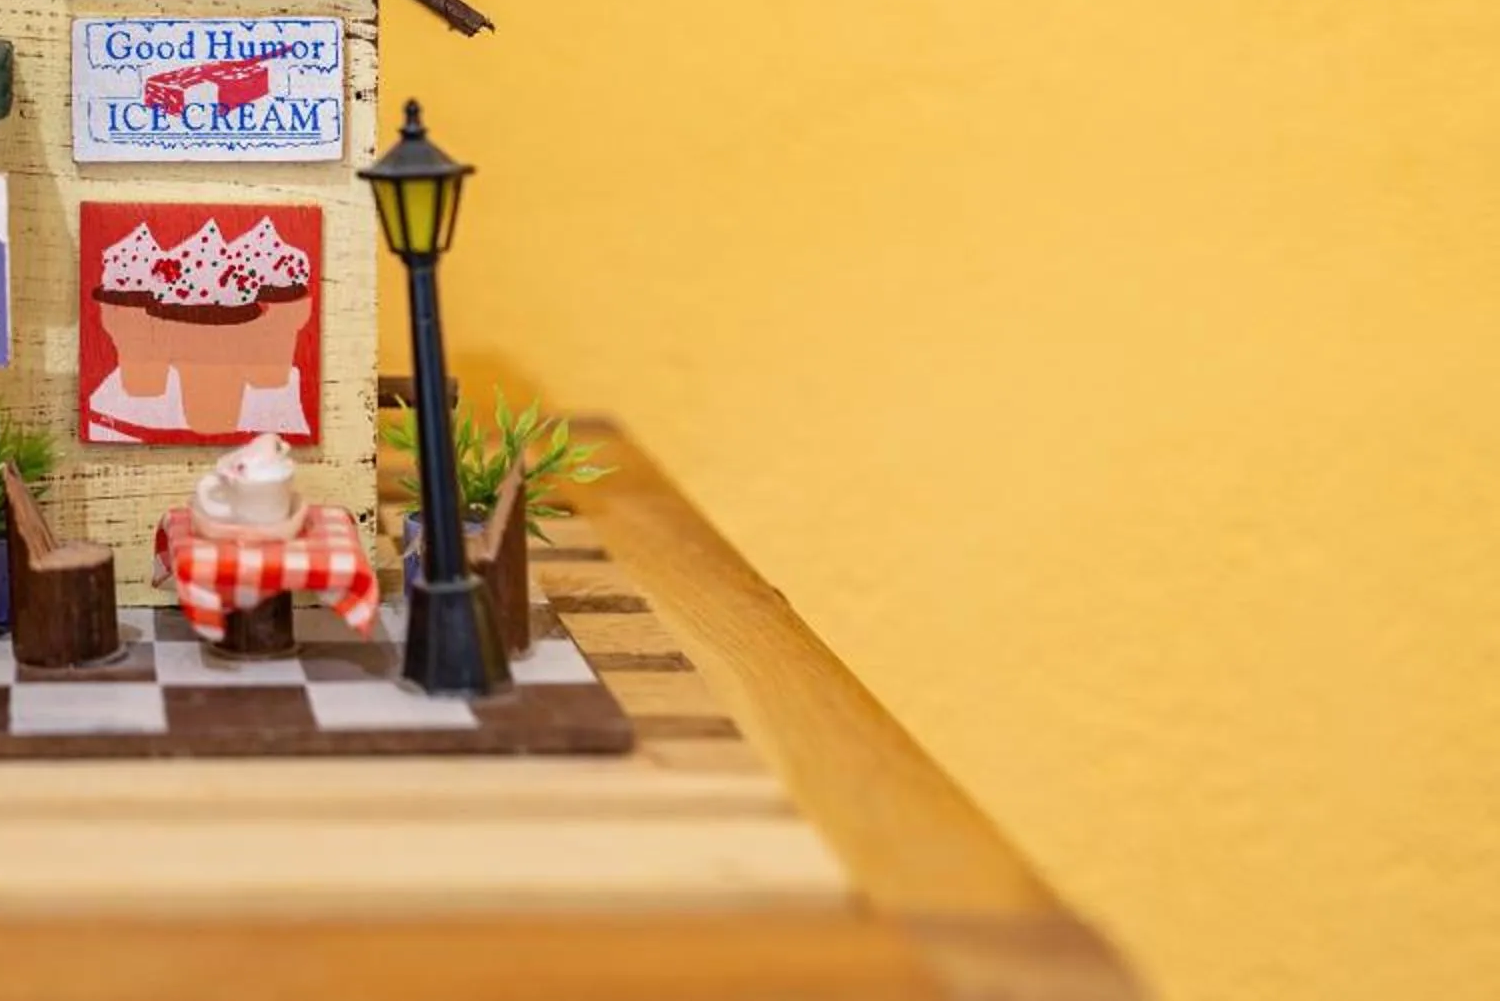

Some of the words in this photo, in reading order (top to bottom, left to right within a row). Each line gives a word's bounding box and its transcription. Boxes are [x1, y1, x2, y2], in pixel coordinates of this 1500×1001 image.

[105, 30, 196, 61] Good
[205, 30, 325, 61] Humor
[108, 102, 171, 132] ICE
[181, 102, 322, 132] CREAM
